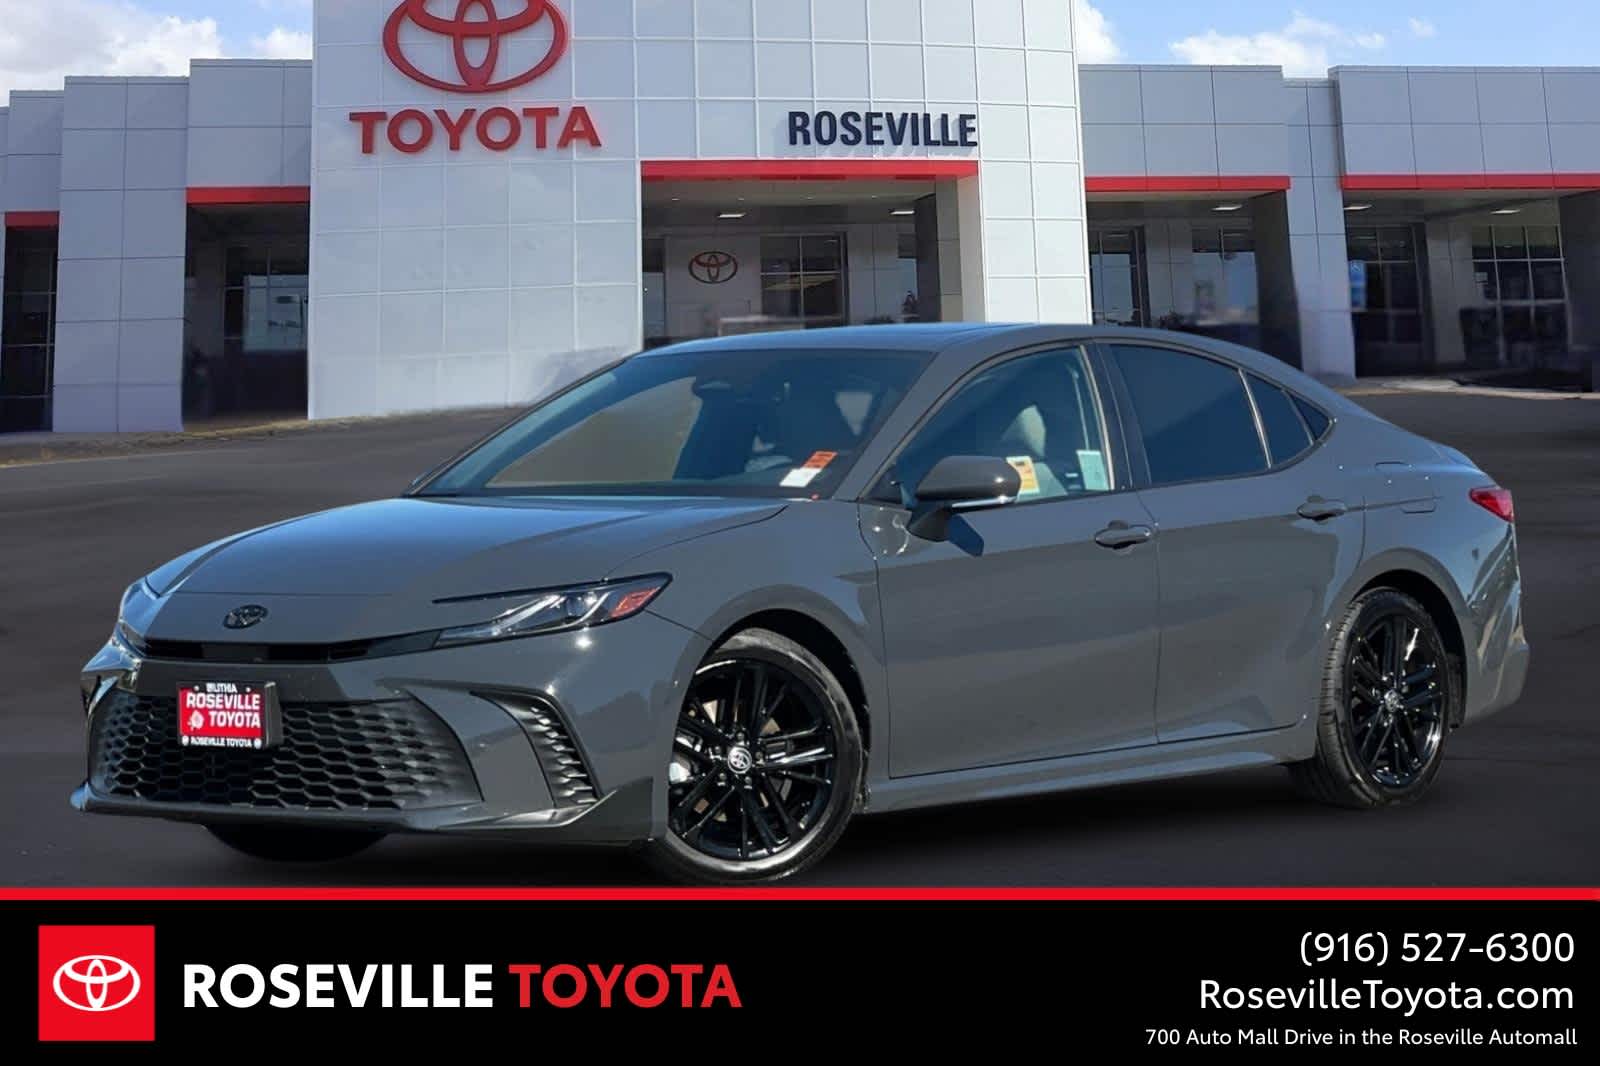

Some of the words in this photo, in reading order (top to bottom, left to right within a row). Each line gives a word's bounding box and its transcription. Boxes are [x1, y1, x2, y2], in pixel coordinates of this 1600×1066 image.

[349, 106, 602, 154] TOYOTA
[788, 110, 978, 147] ROSEVILLE
[186, 692, 261, 710] ROSEVILLE
[208, 710, 261, 728] TOYOTA
[226, 738, 252, 748] TOYOTA
